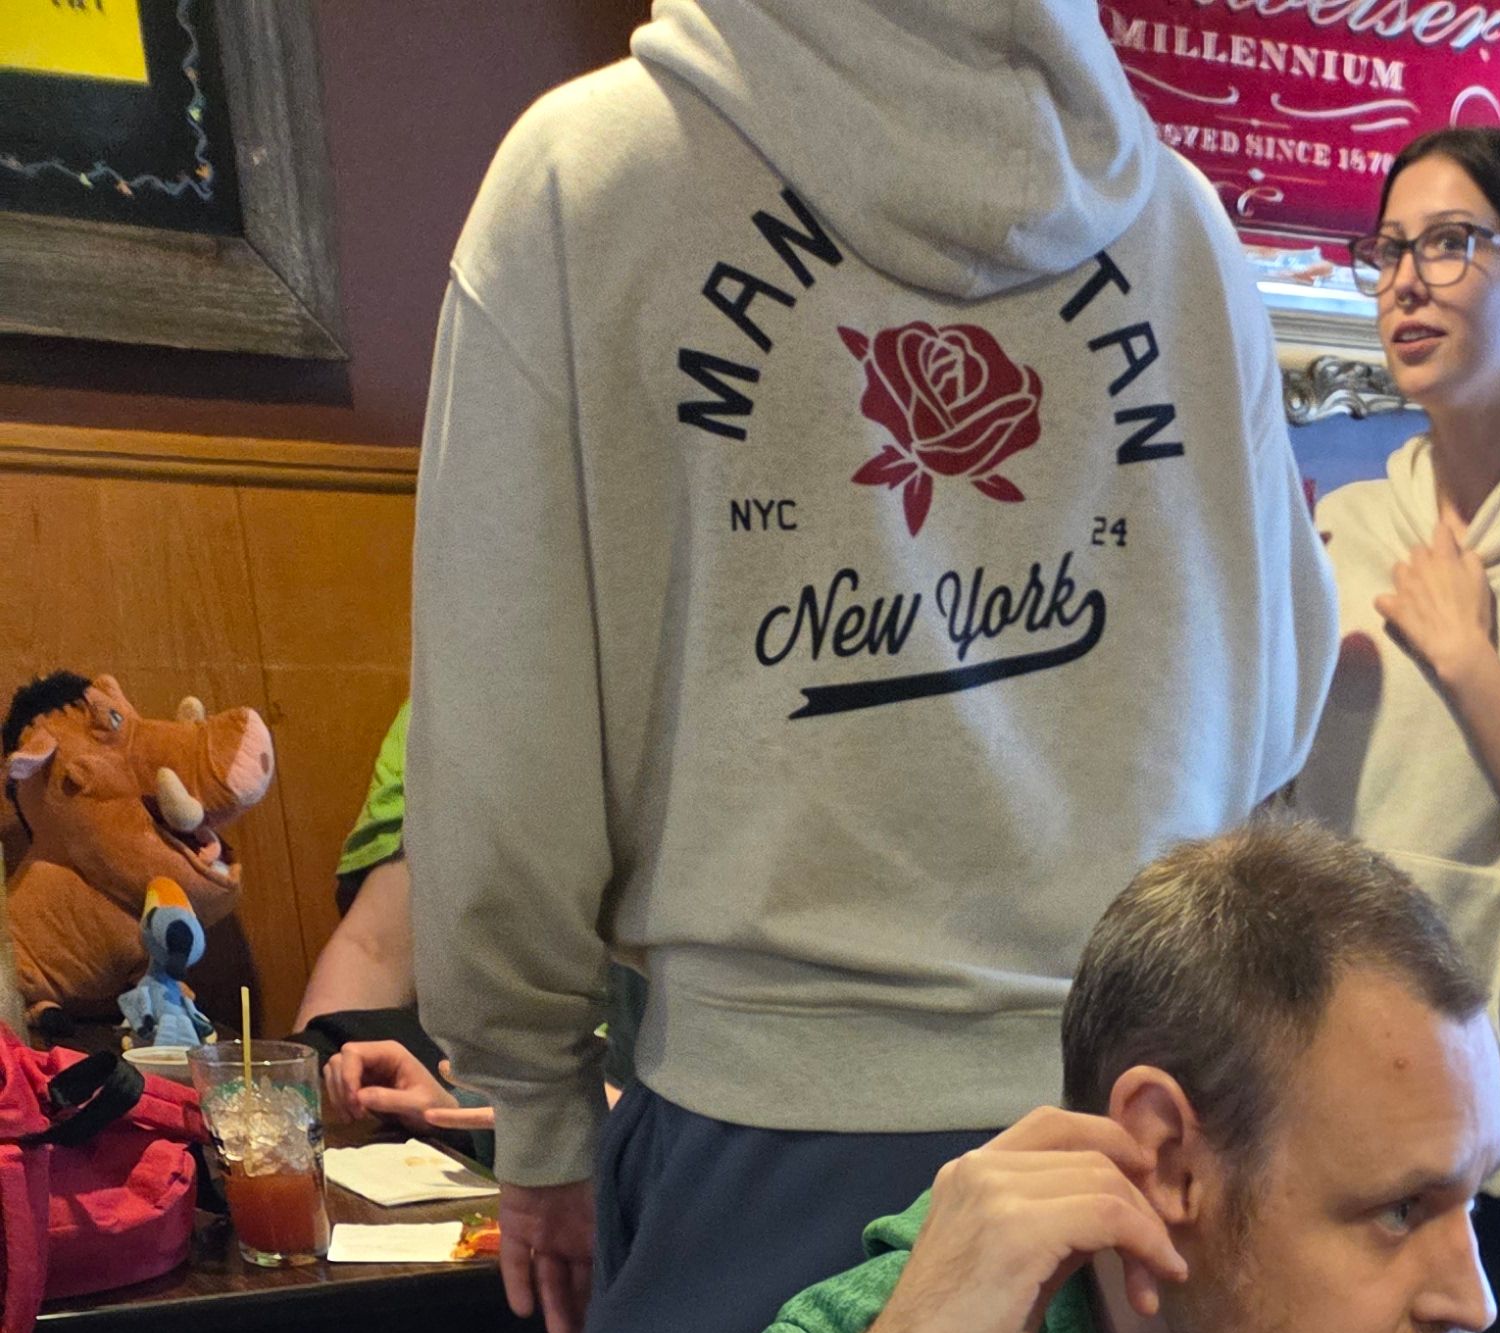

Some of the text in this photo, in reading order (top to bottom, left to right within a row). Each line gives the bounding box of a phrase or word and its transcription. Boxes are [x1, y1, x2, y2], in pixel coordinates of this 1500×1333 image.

[1108, 7, 1406, 91] MILLENNIUM
[1244, 132, 1332, 167] SINCE
[731, 499, 798, 531] NYC
[1092, 516, 1127, 546] 24
[755, 551, 1096, 667] New York
